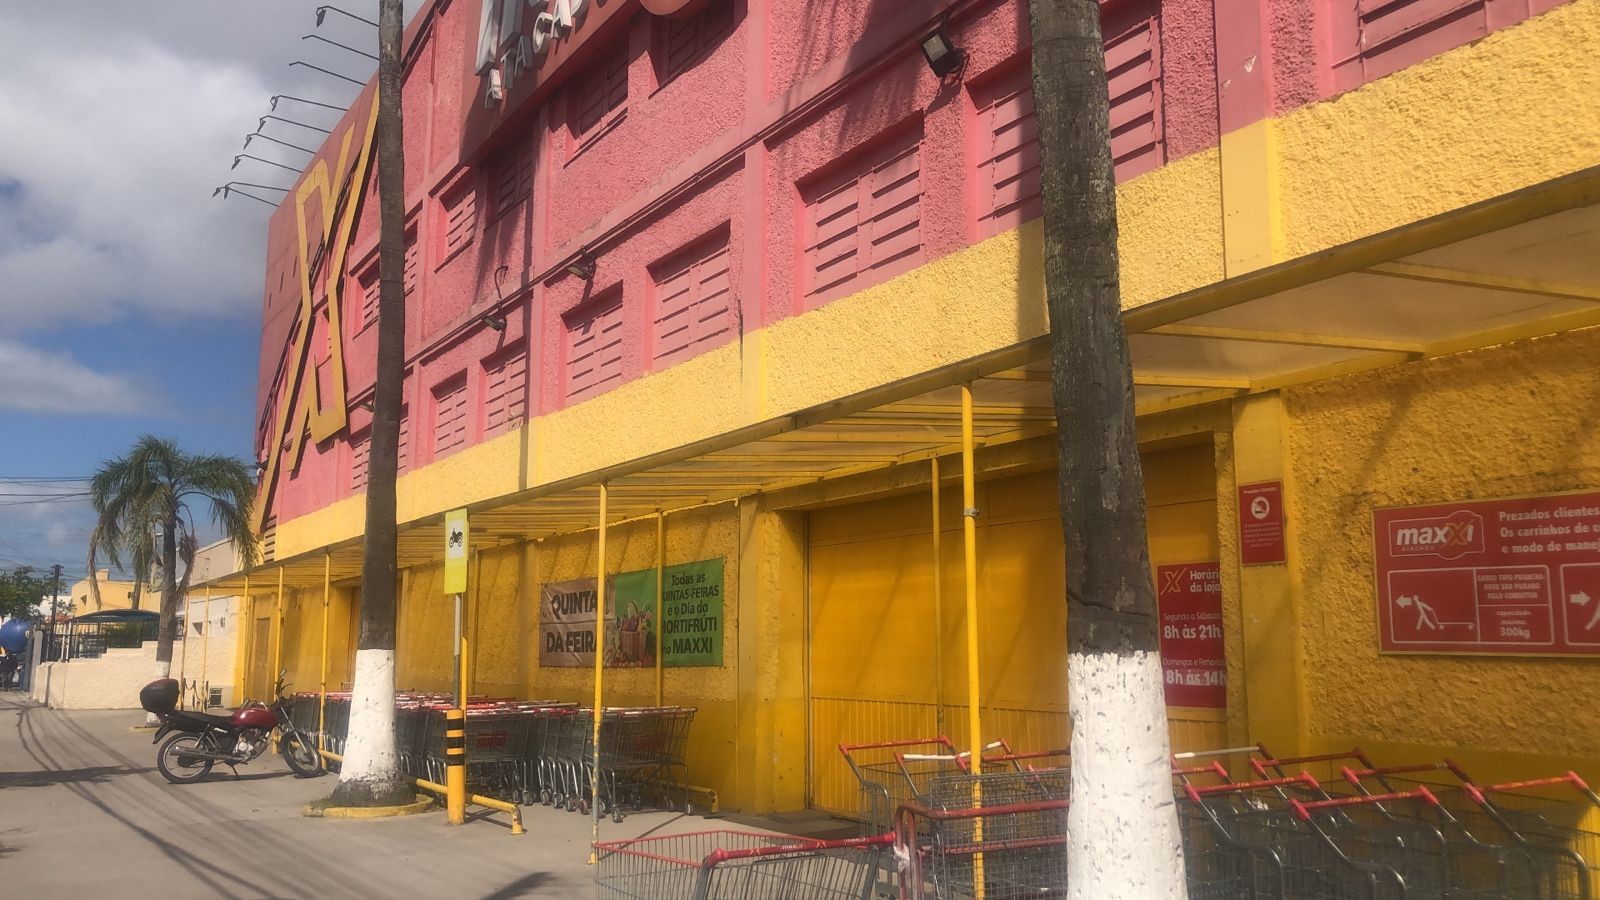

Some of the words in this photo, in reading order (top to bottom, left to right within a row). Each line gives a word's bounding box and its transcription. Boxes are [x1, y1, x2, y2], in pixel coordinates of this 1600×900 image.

[484, 0, 584, 109] ATACA
[1499, 509, 1550, 521] Prezados
[1553, 507, 1600, 518] clientes
[1500, 527, 1514, 538] Os
[1517, 525, 1571, 537] carrinhos
[1574, 522, 1590, 534] de
[1502, 545, 1509, 554] e
[1512, 541, 1544, 553] modo
[1547, 541, 1562, 552] de
[1565, 538, 1600, 553] manej
[671, 573, 694, 586] Todas
[696, 573, 706, 583] as
[1190, 582, 1202, 593] da
[1204, 581, 1221, 594] loja
[662, 585, 719, 602] UINTAS-FEIRAS
[667, 604, 673, 616] é
[674, 606, 680, 616] o
[681, 602, 695, 615] Dia
[696, 601, 709, 614] do
[1164, 625, 1180, 639] 8h
[1182, 624, 1197, 639] às
[1198, 624, 1221, 640] 21h
[1500, 627, 1530, 639] 300kg
[546, 631, 564, 653] DA
[565, 630, 598, 653] FEIR
[673, 637, 713, 654] MAXXI
[1162, 657, 1193, 667] Domingos
[1166, 669, 1183, 685] 8h
[1186, 669, 1200, 685] às
[1202, 670, 1226, 686] 14h
